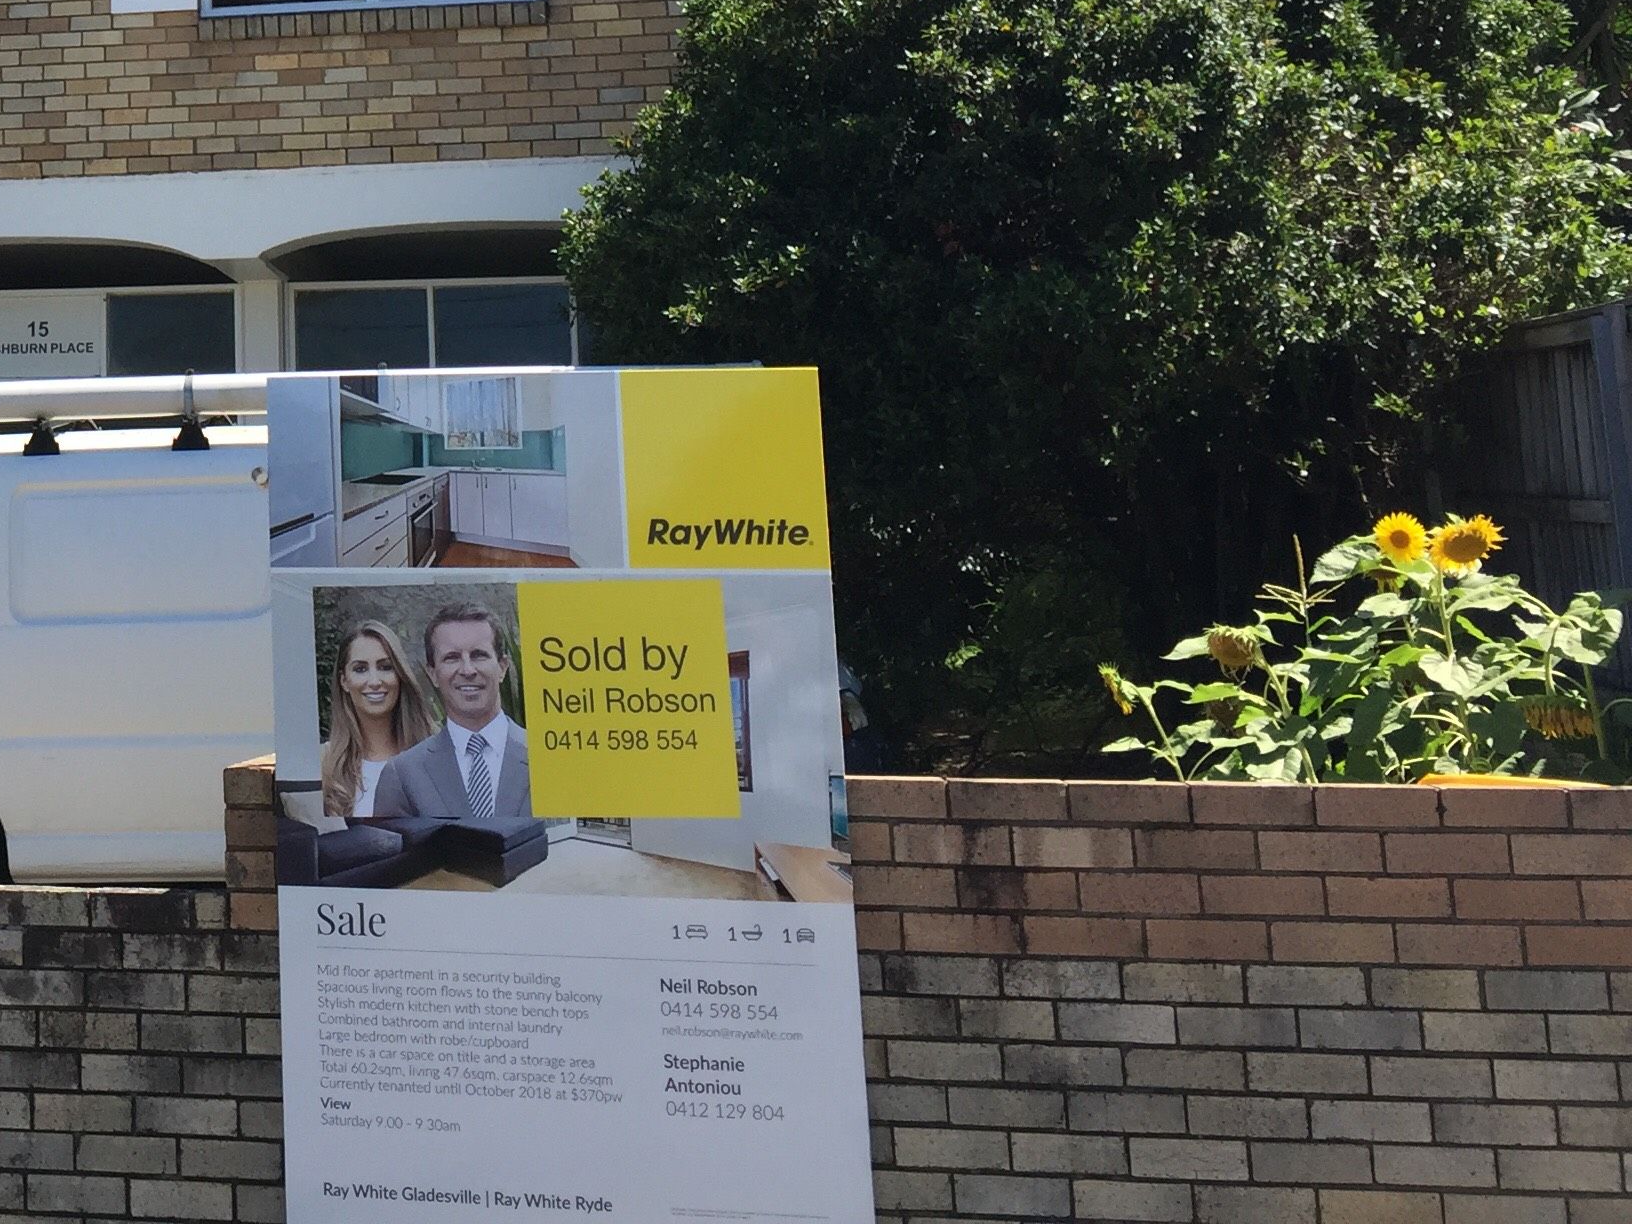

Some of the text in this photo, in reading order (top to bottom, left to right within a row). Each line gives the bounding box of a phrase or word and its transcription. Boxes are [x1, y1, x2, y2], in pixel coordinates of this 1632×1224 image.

[27, 321, 49, 337] 15
[50, 342, 94, 354] PLACE
[539, 636, 688, 680] Sold by
[542, 687, 716, 713] Neil Robson
[544, 729, 698, 750] 0414 598 554
[317, 902, 386, 937] Sale
[672, 925, 792, 943] 1 1 1
[318, 964, 561, 988] Mid floor apartment in a security building
[317, 980, 602, 1006] Spacious living room flows to the sunny balcony
[660, 978, 758, 996] Neil Robson
[318, 996, 590, 1021] Stylish modern kitchen with stone bench tops
[660, 1001, 778, 1021] 0414 598 554
[318, 1012, 563, 1036] Combined bathroom and internal laundry
[319, 1030, 529, 1049] Large bedroom with robe/cupboard
[319, 1044, 595, 1069] There is a car space on title and a storage area
[664, 1053, 745, 1073] Stephanie
[320, 1060, 347, 1073] Total
[409, 1065, 440, 1080] living
[503, 1071, 556, 1083] carspace
[320, 1077, 622, 1104] Currently tenanted until October 2018 at $370pw
[665, 1077, 741, 1095] Antoniou
[320, 1097, 352, 1110] View
[666, 1101, 784, 1121] 0412 129 804
[321, 1113, 372, 1129] Saturday
[415, 1118, 461, 1132] 930am
[323, 1182, 349, 1200] Ray
[352, 1183, 398, 1200] White
[401, 1186, 481, 1205] Gladesville
[495, 1191, 520, 1209] Ray
[524, 1193, 570, 1210] White
[575, 1196, 613, 1214] Ryde
